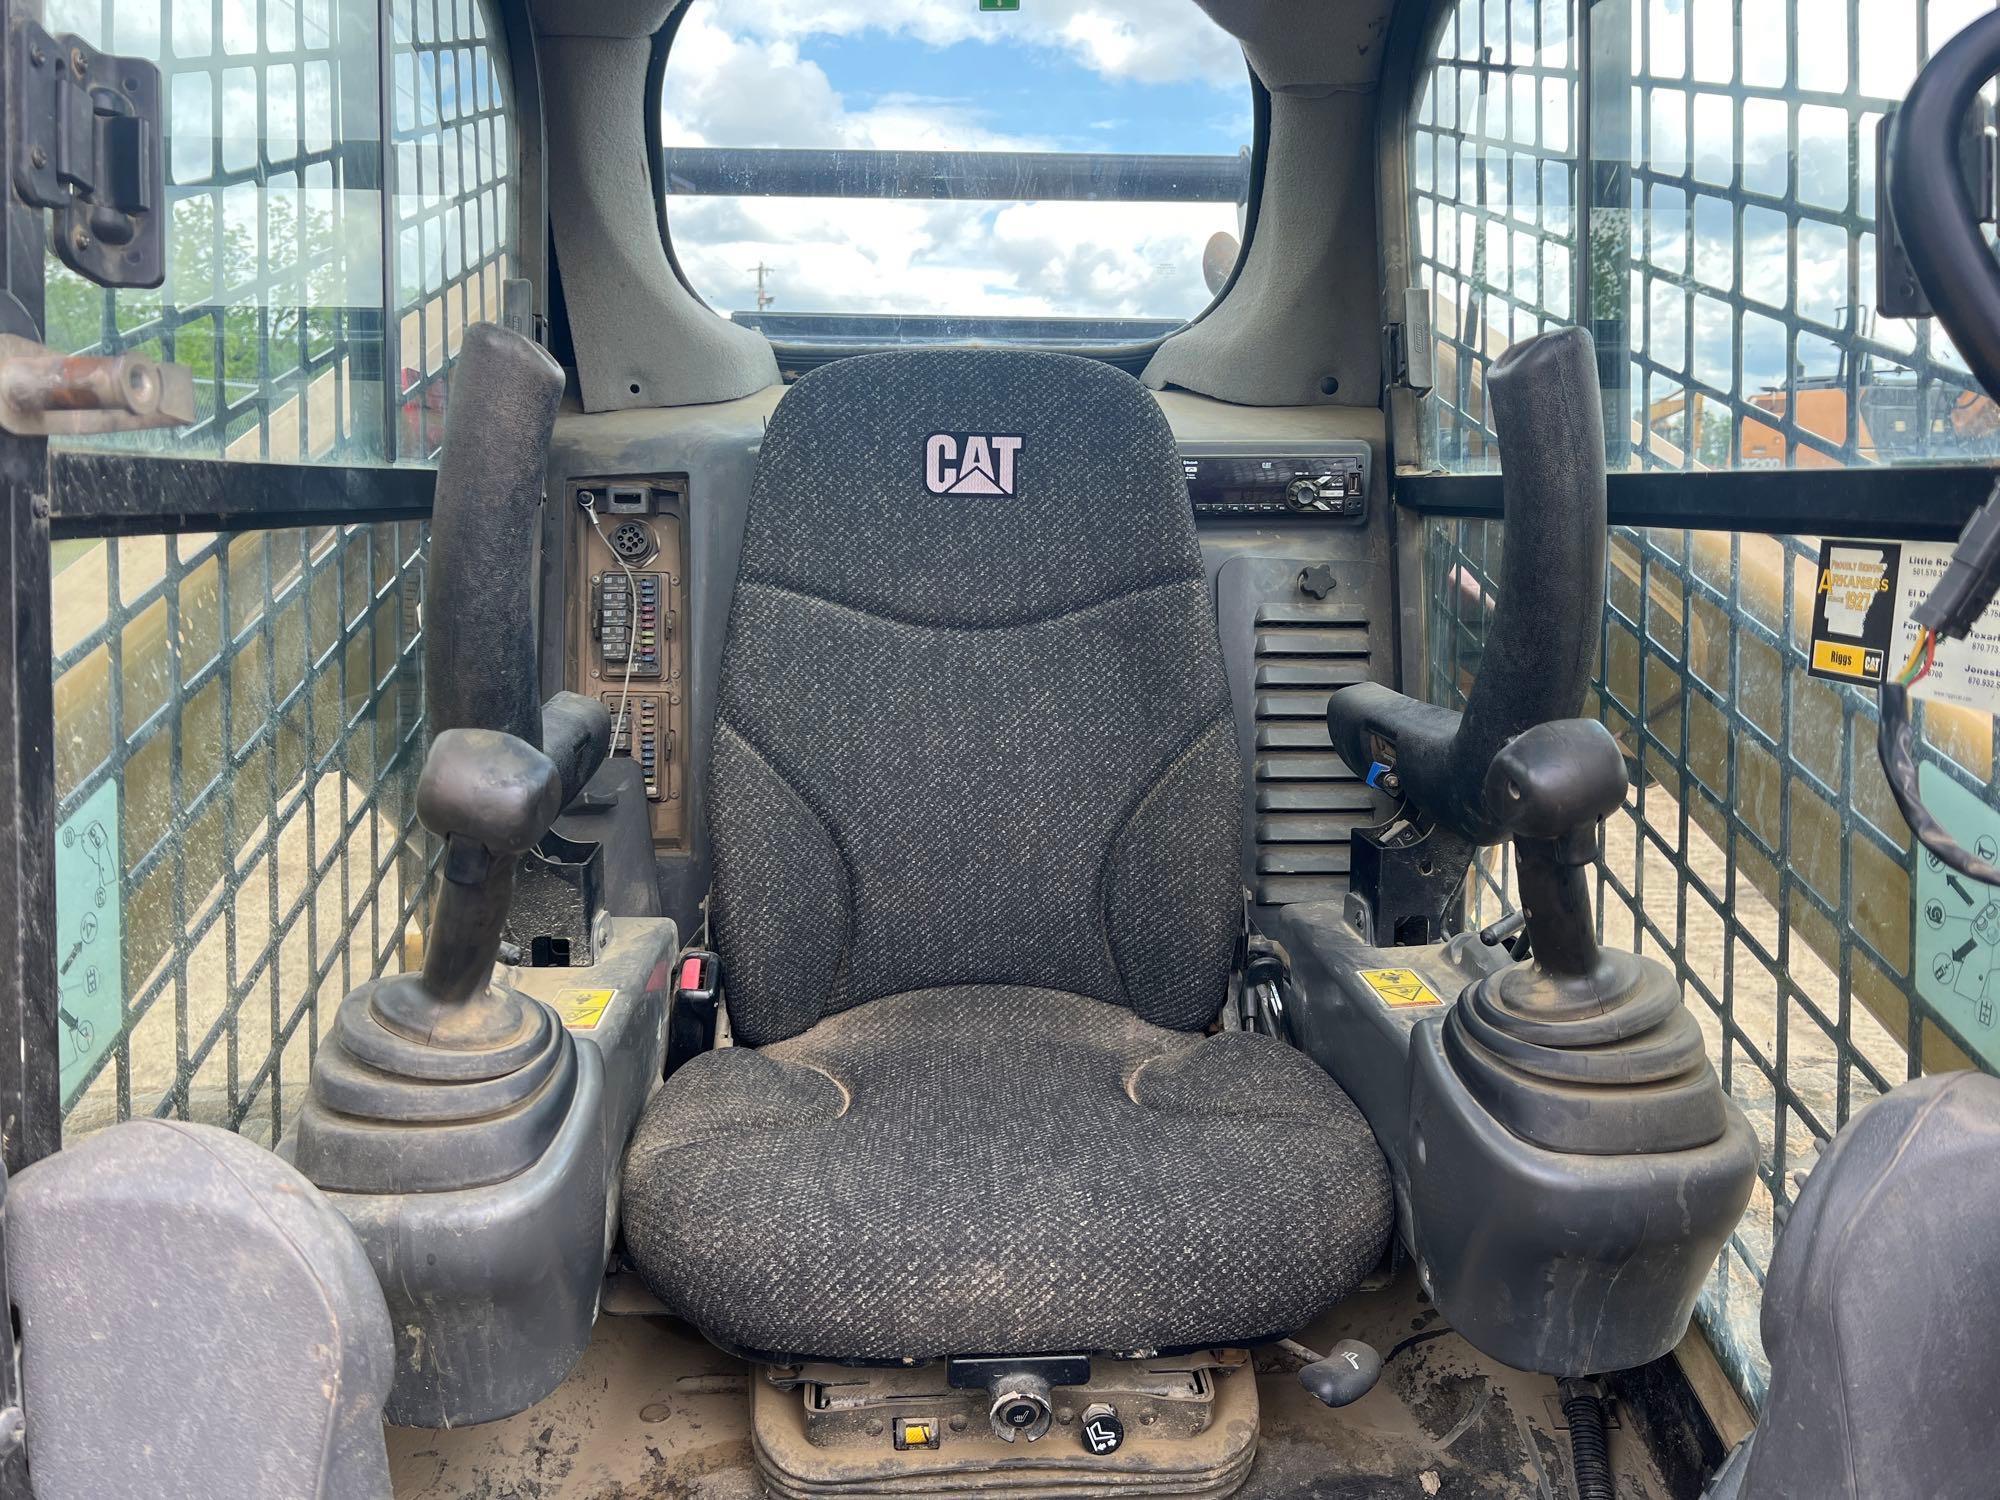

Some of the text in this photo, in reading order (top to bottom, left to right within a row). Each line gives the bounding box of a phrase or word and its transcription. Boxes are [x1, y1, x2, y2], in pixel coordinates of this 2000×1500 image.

[927, 434, 1022, 494] CAT
[1909, 556, 1933, 566] Little
[1818, 569, 1889, 592] ARKANSAS
[1912, 567, 1943, 577] 501.570.3
[1845, 590, 1871, 612] 1927
[1969, 630, 2000, 641] Texar
[1831, 651, 1881, 672] Riggs CAT
